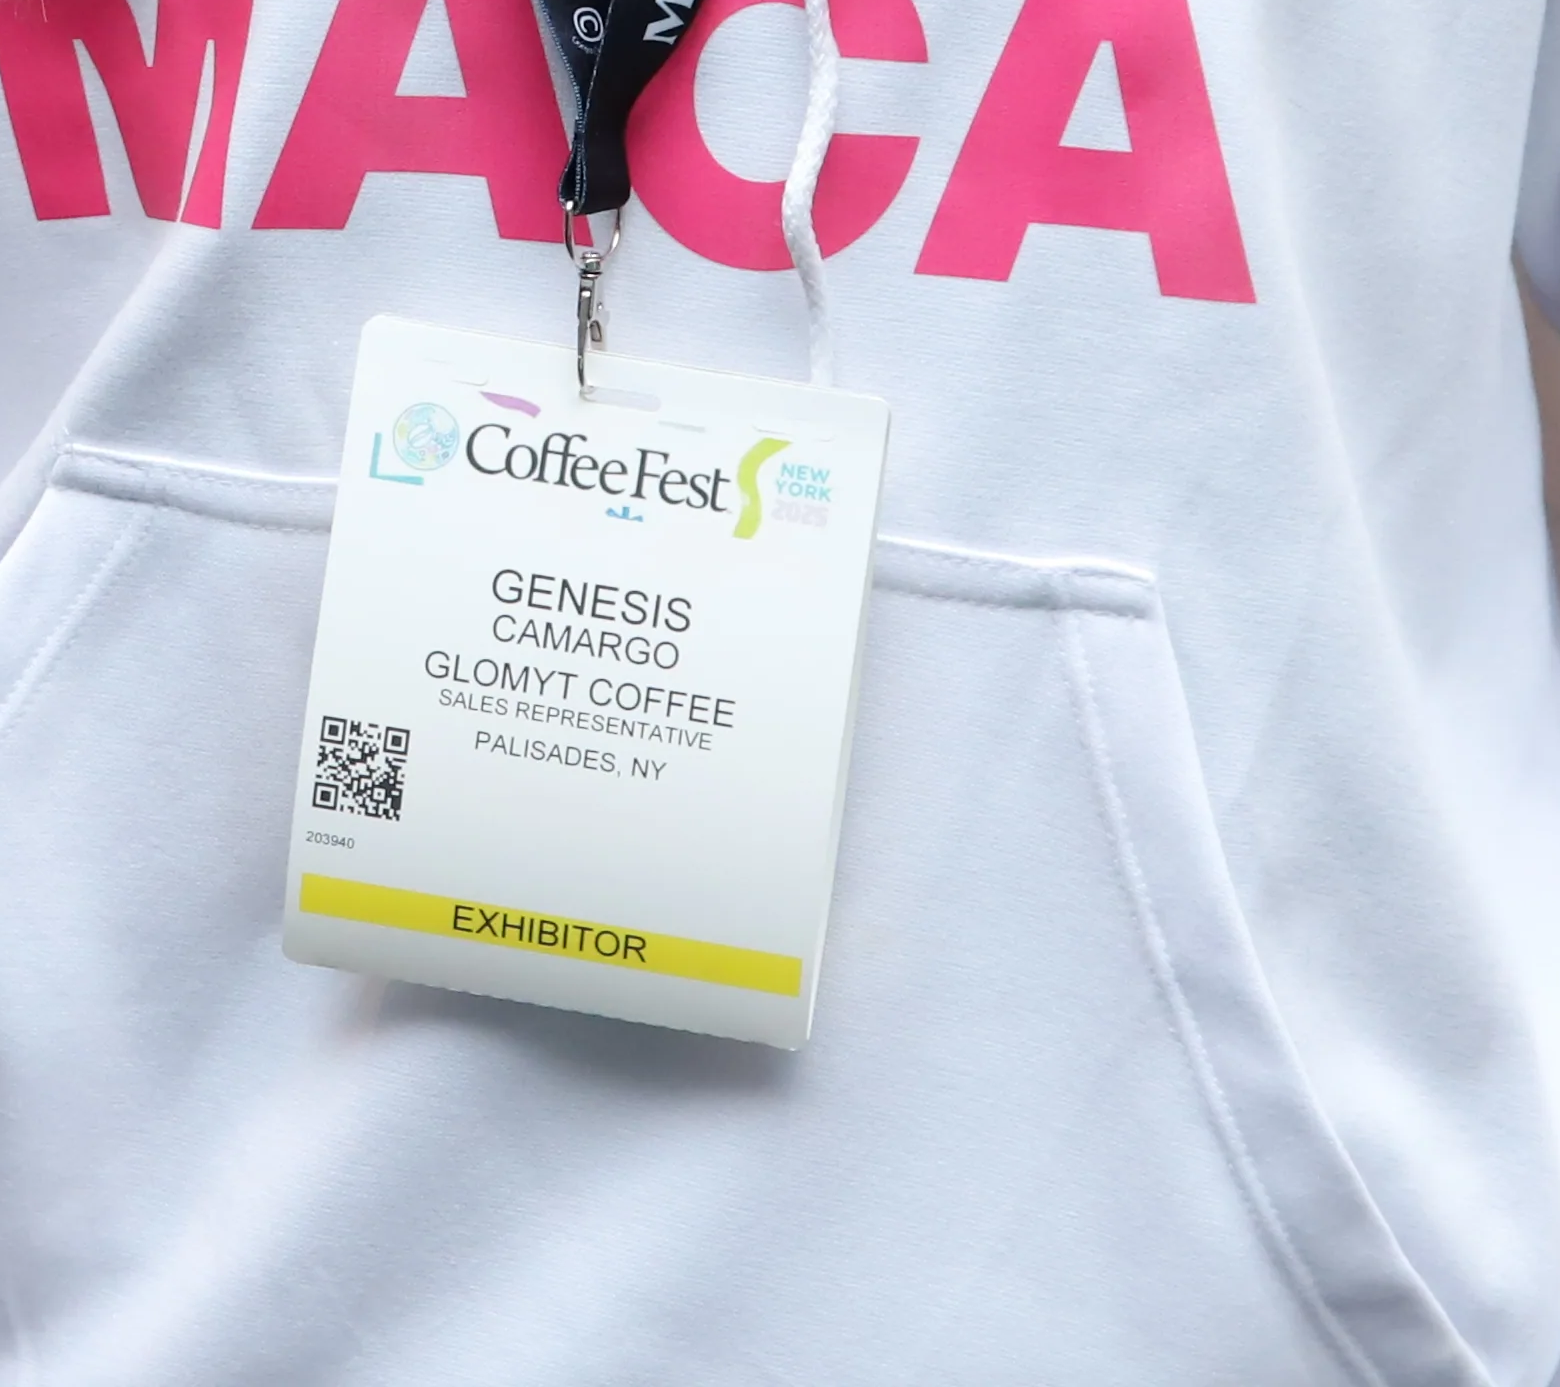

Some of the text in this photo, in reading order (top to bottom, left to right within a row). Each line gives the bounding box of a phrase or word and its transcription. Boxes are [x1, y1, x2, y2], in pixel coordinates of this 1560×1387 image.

[775, 477, 834, 504] YORK
[780, 462, 831, 485] NEW
[491, 568, 692, 633] GENESIS
[492, 614, 680, 670] CAMARGO
[424, 650, 736, 729] GLOMYT COFFEE
[438, 688, 713, 751] SALES REPRESENTATIVE
[474, 730, 667, 782] PALISADES, NY
[305, 830, 355, 849] 203940
[452, 904, 647, 963] EXHIBITOR
